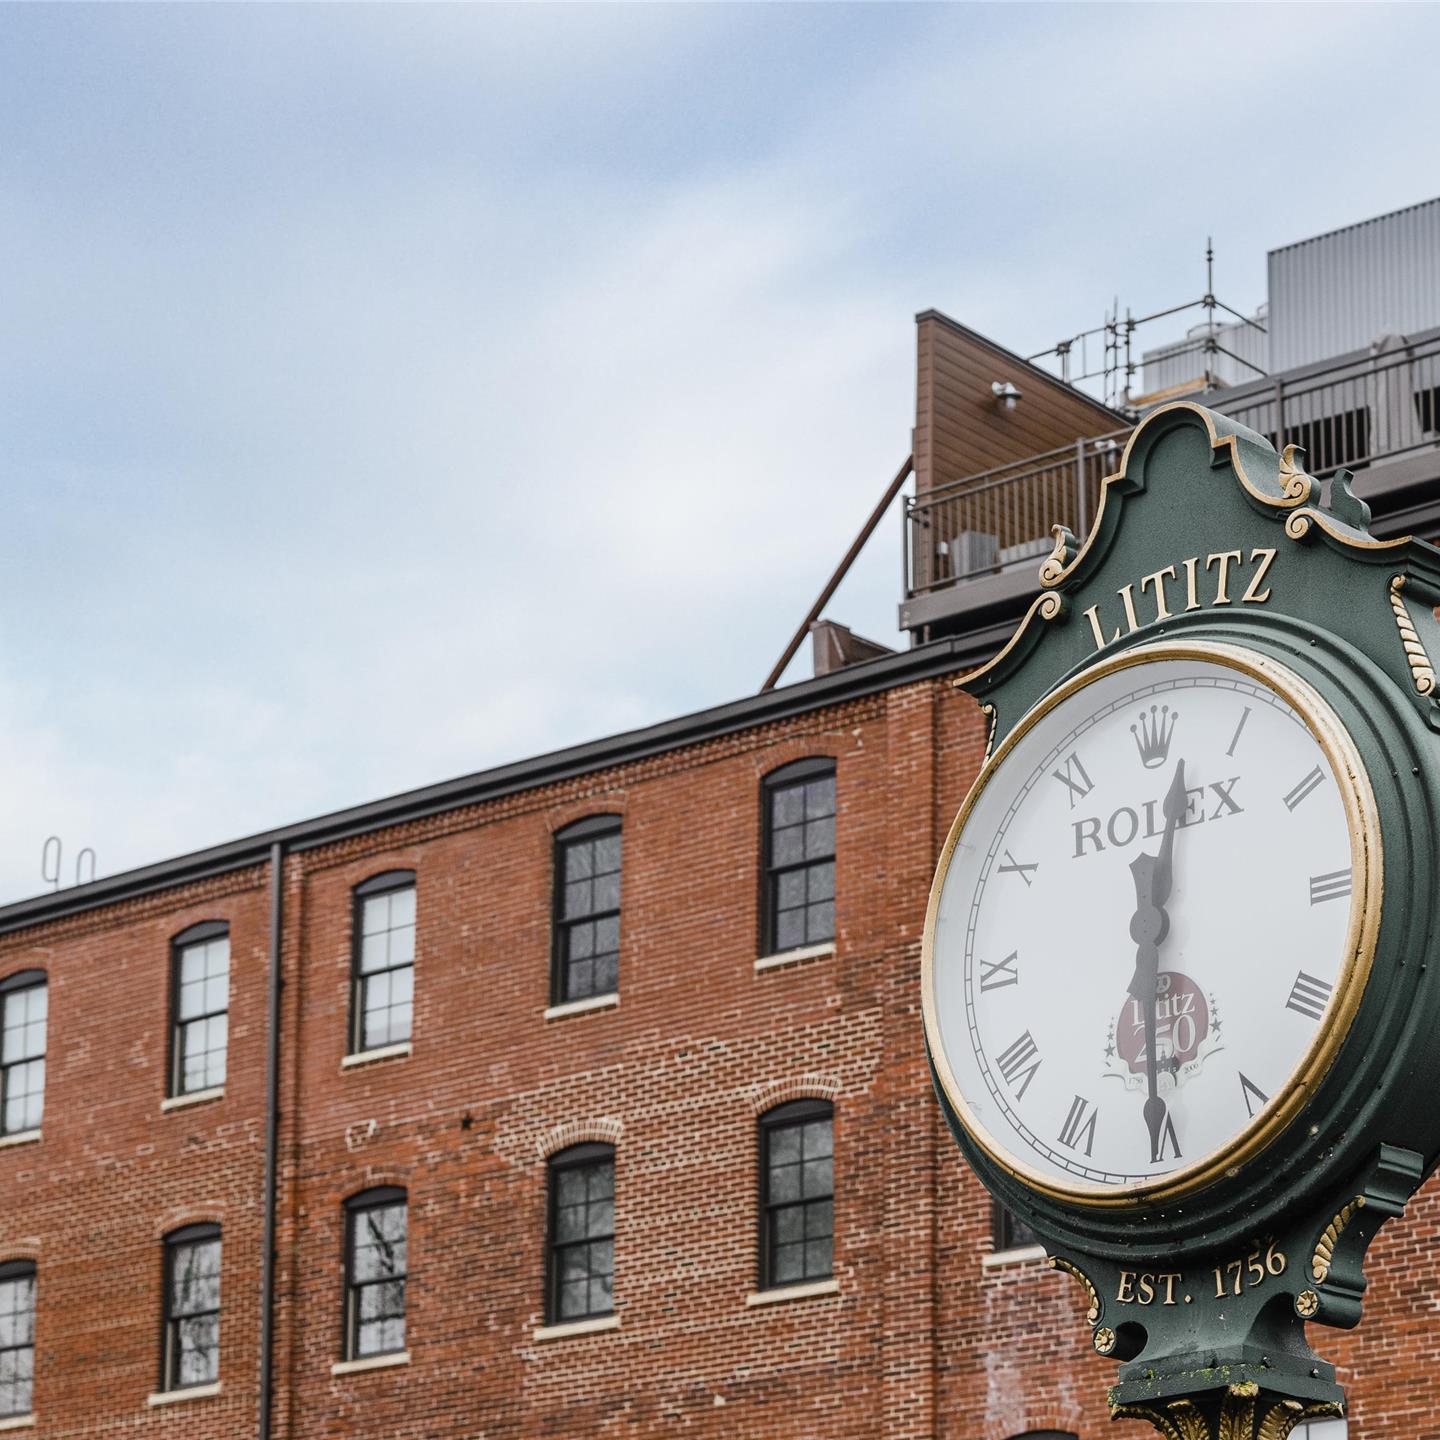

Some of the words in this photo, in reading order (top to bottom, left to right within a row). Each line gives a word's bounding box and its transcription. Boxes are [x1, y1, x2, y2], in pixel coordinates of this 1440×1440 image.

[1083, 548, 1277, 650] LITITZ
[1071, 776, 1244, 858] ROLEX
[1131, 993, 1195, 1026] Ltitz
[1116, 1271, 1192, 1305] EST.
[1212, 1240, 1286, 1298] 1756
